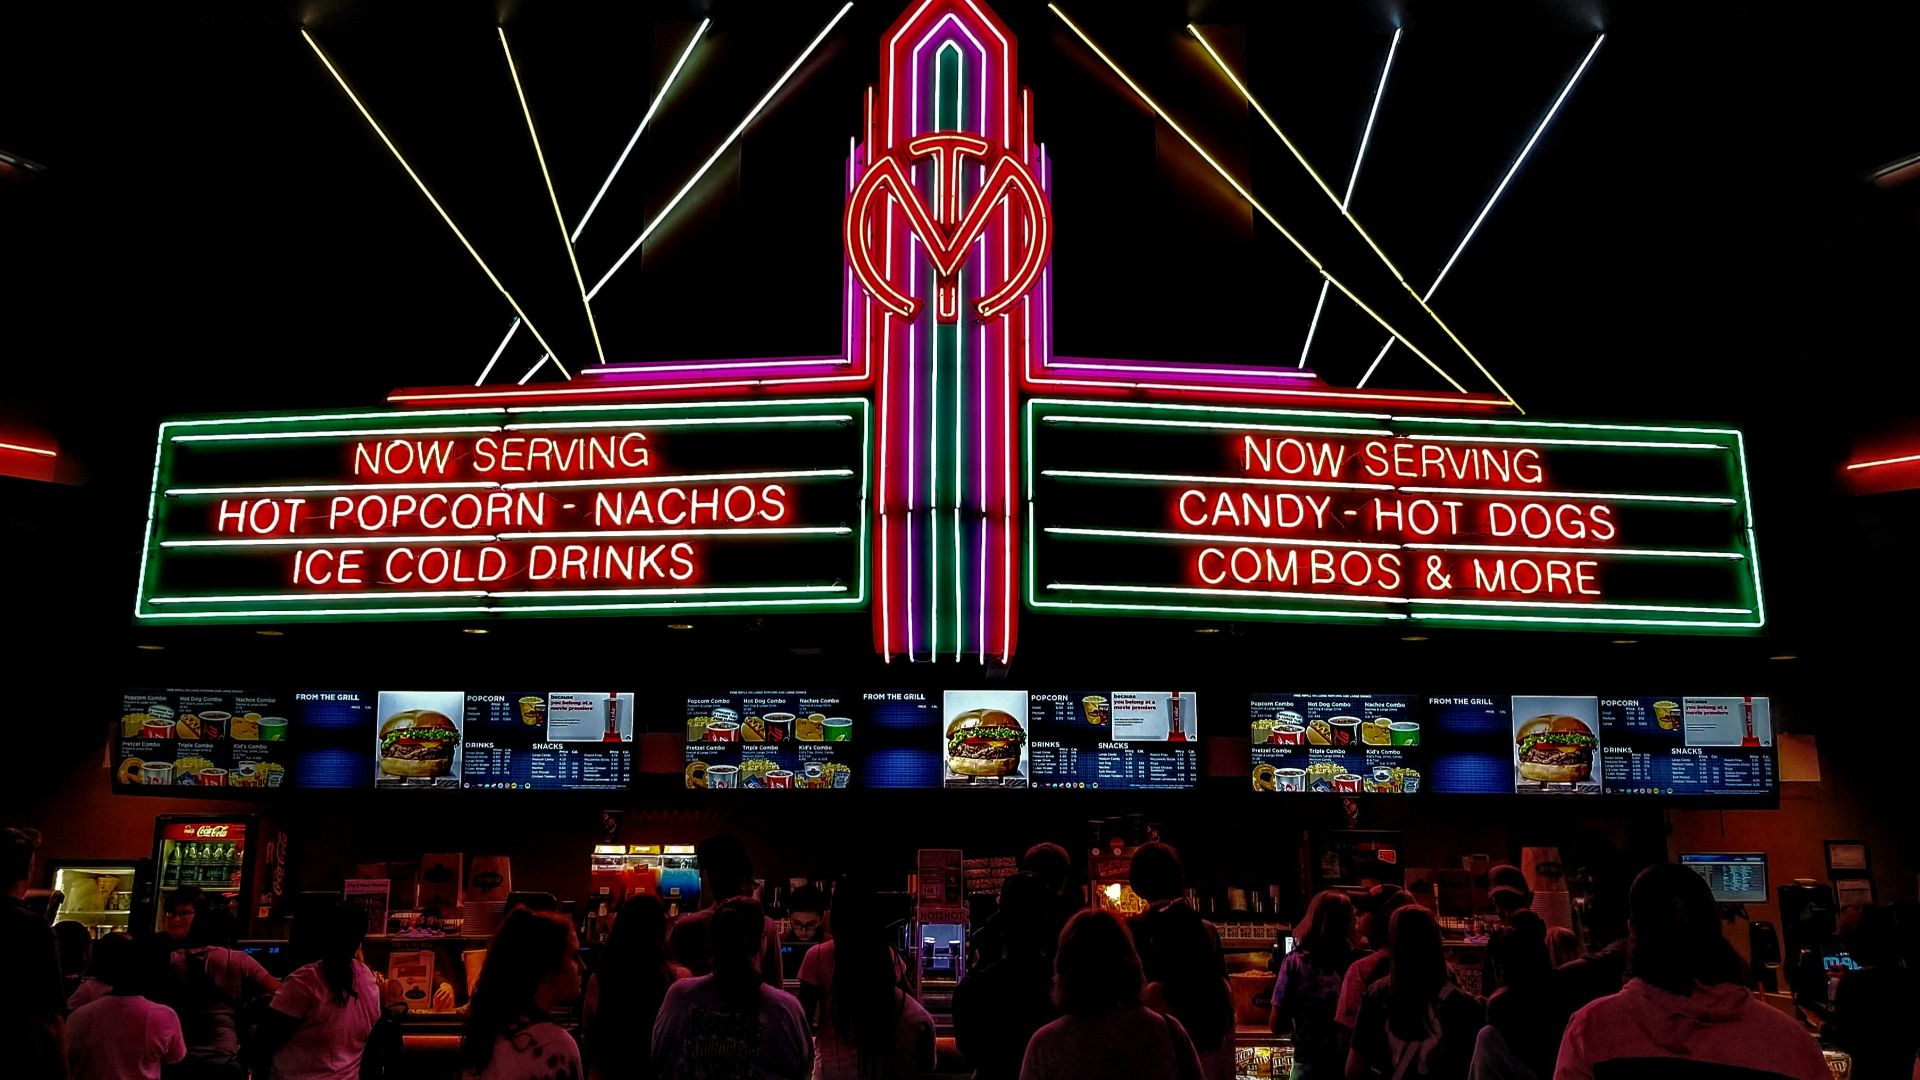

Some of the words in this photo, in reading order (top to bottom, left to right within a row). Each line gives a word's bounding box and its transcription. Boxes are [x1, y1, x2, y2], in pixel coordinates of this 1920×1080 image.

[353, 439, 454, 477] NOW
[472, 432, 650, 474] SERVING
[1243, 435, 1345, 478] NOW
[1364, 442, 1543, 485] SERVING
[217, 498, 306, 534] HOT
[329, 491, 546, 532] POPCORN
[594, 484, 788, 527] NACHOS
[1178, 490, 1331, 531] CANDY
[1375, 499, 1464, 536] HOT
[1489, 502, 1617, 541] DOGS
[292, 549, 362, 585] ICE
[384, 545, 507, 583] COLD
[528, 542, 695, 581] DRINKS
[1427, 555, 1453, 591] &
[1473, 558, 1602, 596] MORE
[296, 693, 318, 701] FROM
[320, 693, 336, 701] THE
[337, 693, 360, 701] GRILL
[863, 693, 885, 701] FROM
[886, 693, 902, 701] THE
[903, 693, 926, 701] GRILL
[1031, 694, 1069, 702] POPCORN
